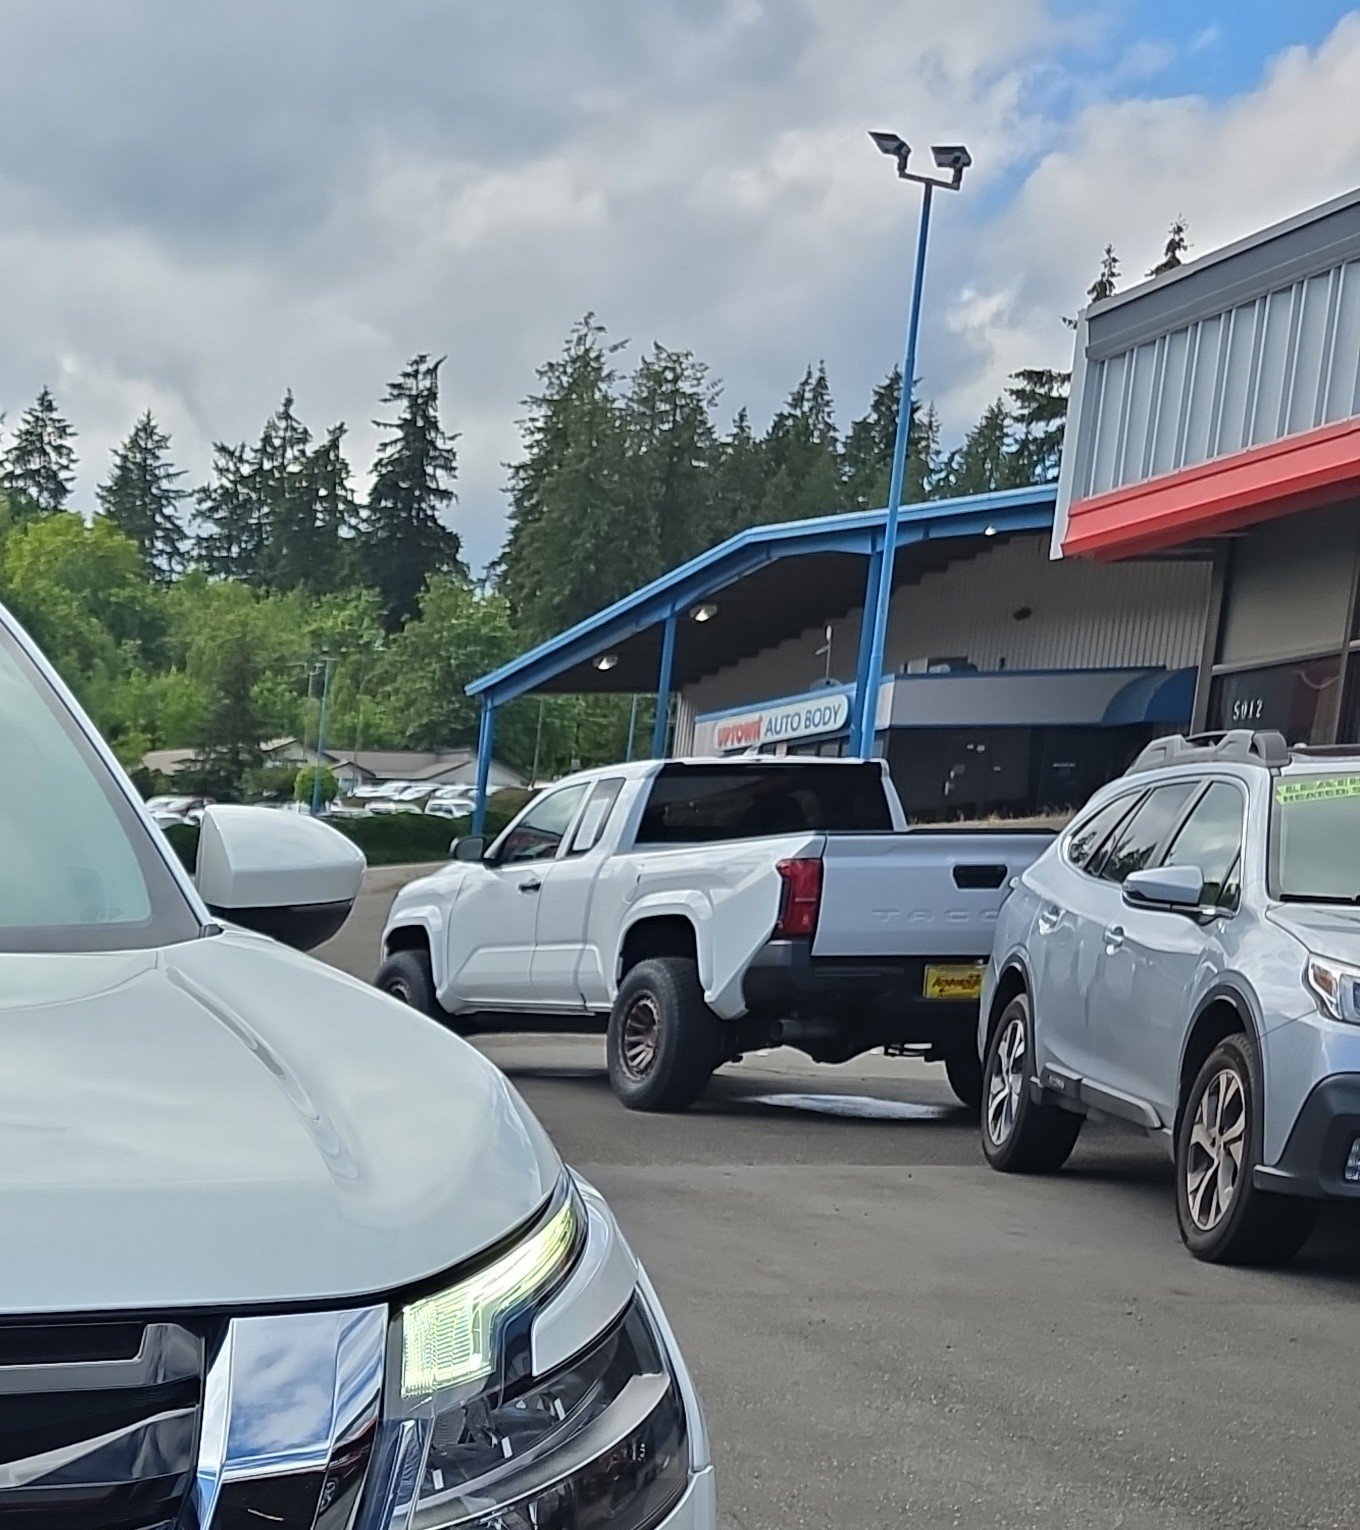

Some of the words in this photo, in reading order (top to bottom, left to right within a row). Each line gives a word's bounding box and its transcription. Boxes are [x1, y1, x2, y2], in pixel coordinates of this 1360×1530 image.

[717, 714, 763, 748] UPTOWN
[764, 713, 801, 738] AUTO
[804, 704, 842, 730] BODY
